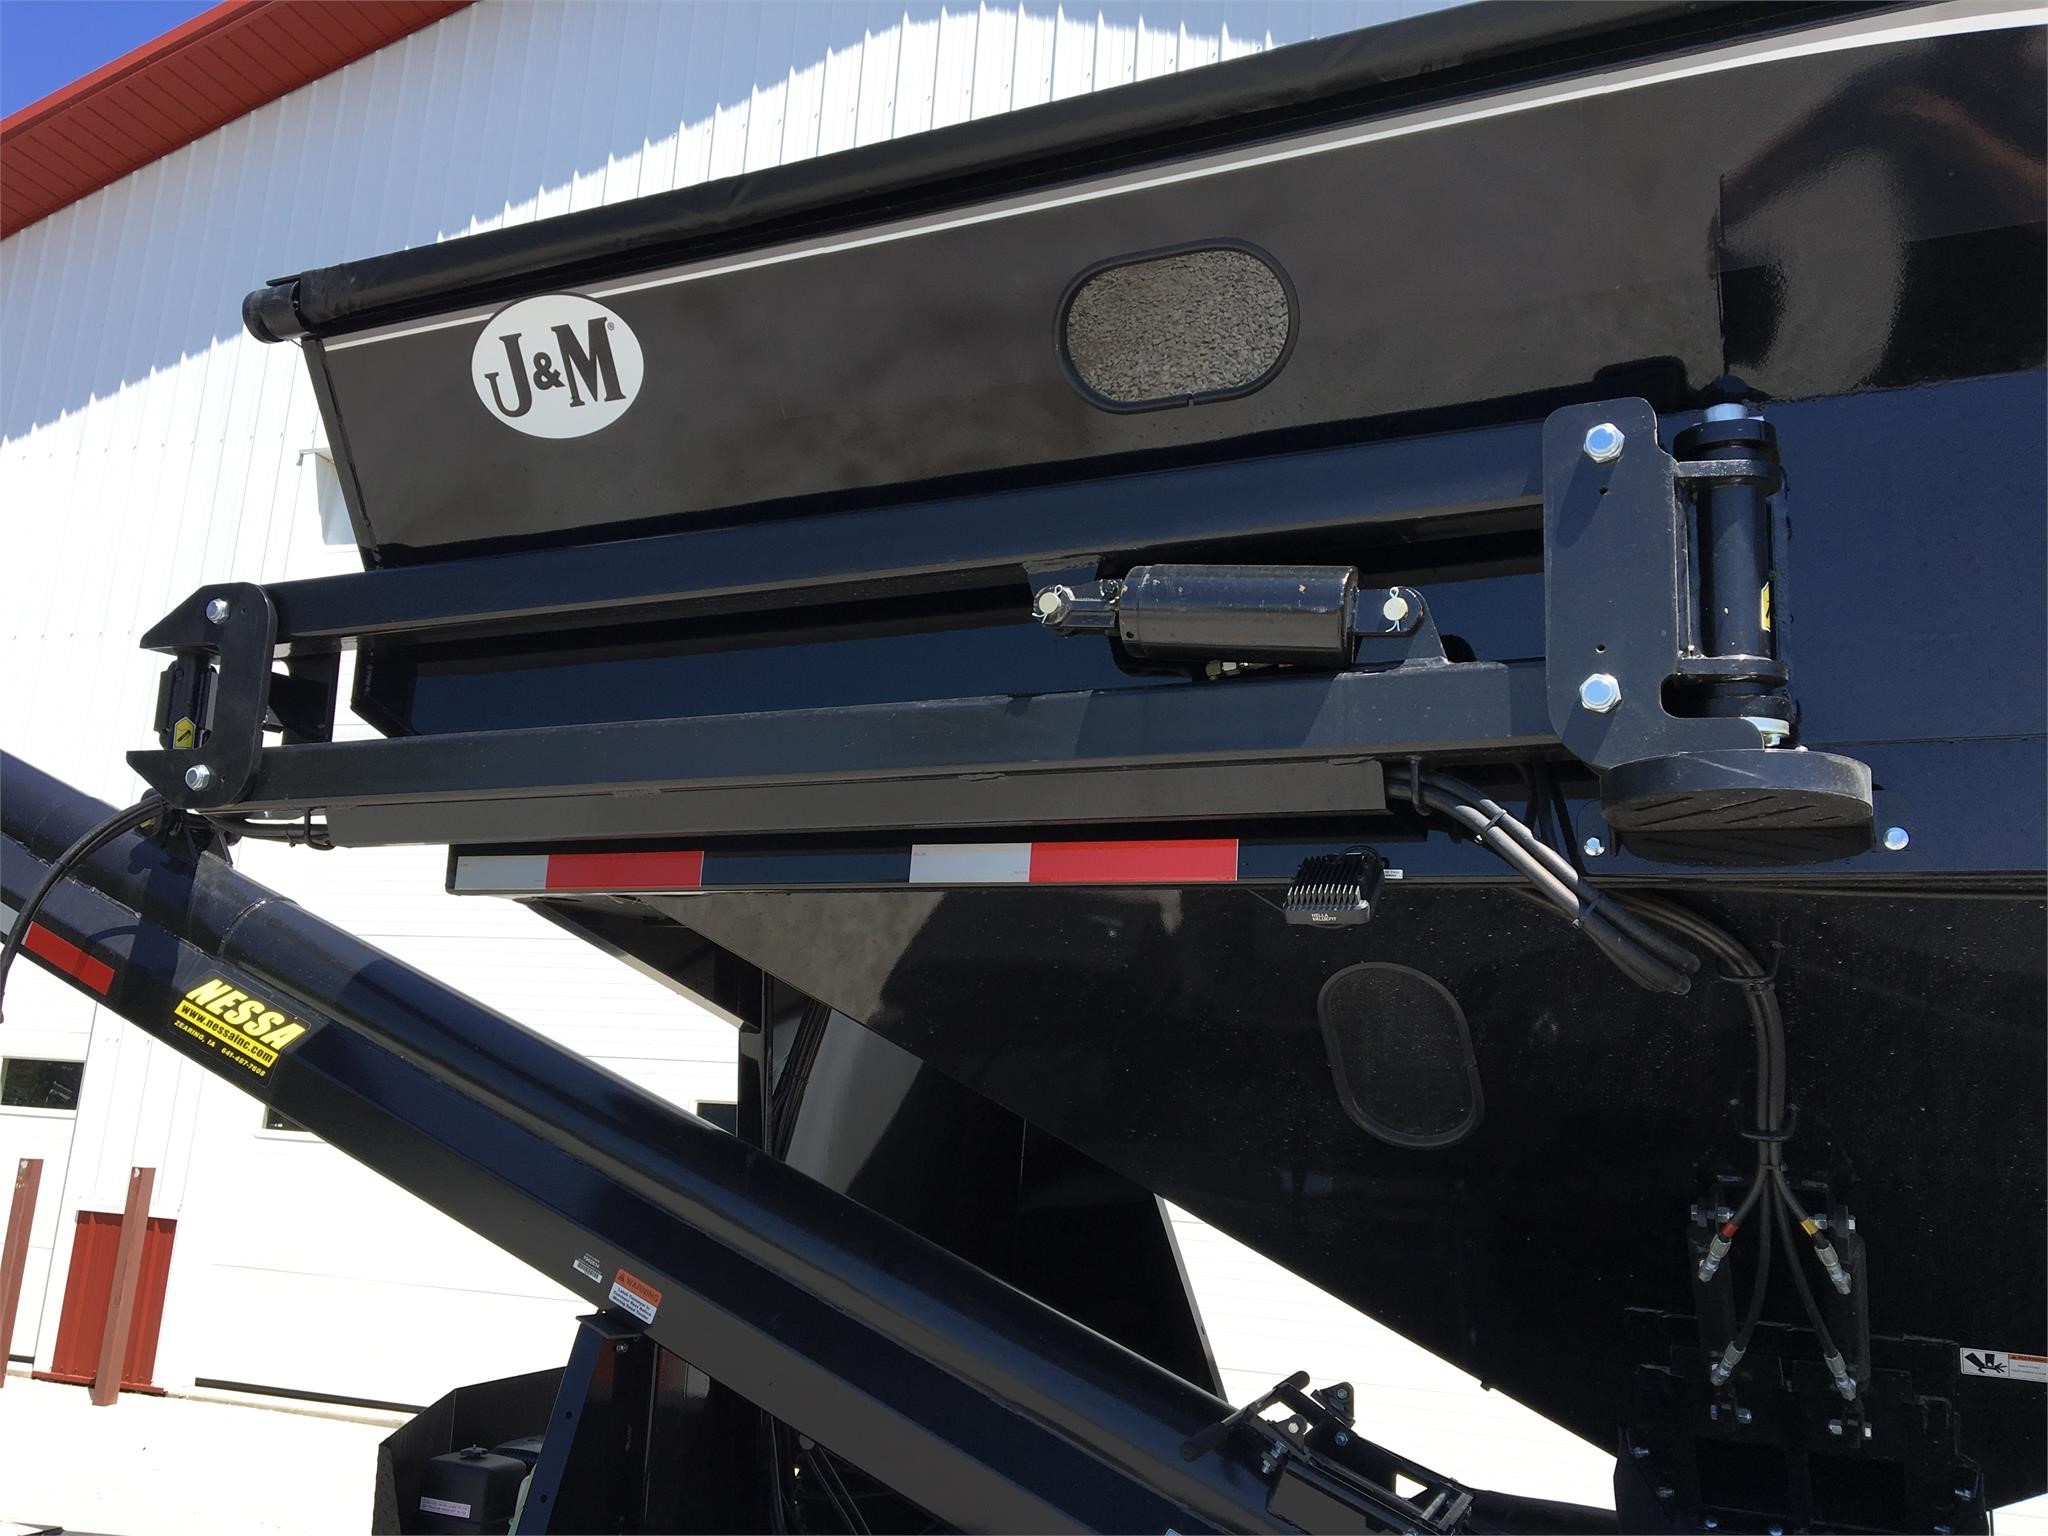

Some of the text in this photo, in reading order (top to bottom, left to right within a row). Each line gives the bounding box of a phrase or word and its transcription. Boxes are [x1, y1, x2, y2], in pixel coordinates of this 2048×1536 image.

[485, 316, 626, 418] J&M
[174, 1020, 206, 1043] ZEARING,
[207, 1038, 216, 1048] IA
[181, 1005, 273, 1063] www.nessainc.com
[185, 979, 306, 1051] NESSA
[626, 1277, 659, 1303] WARNING
